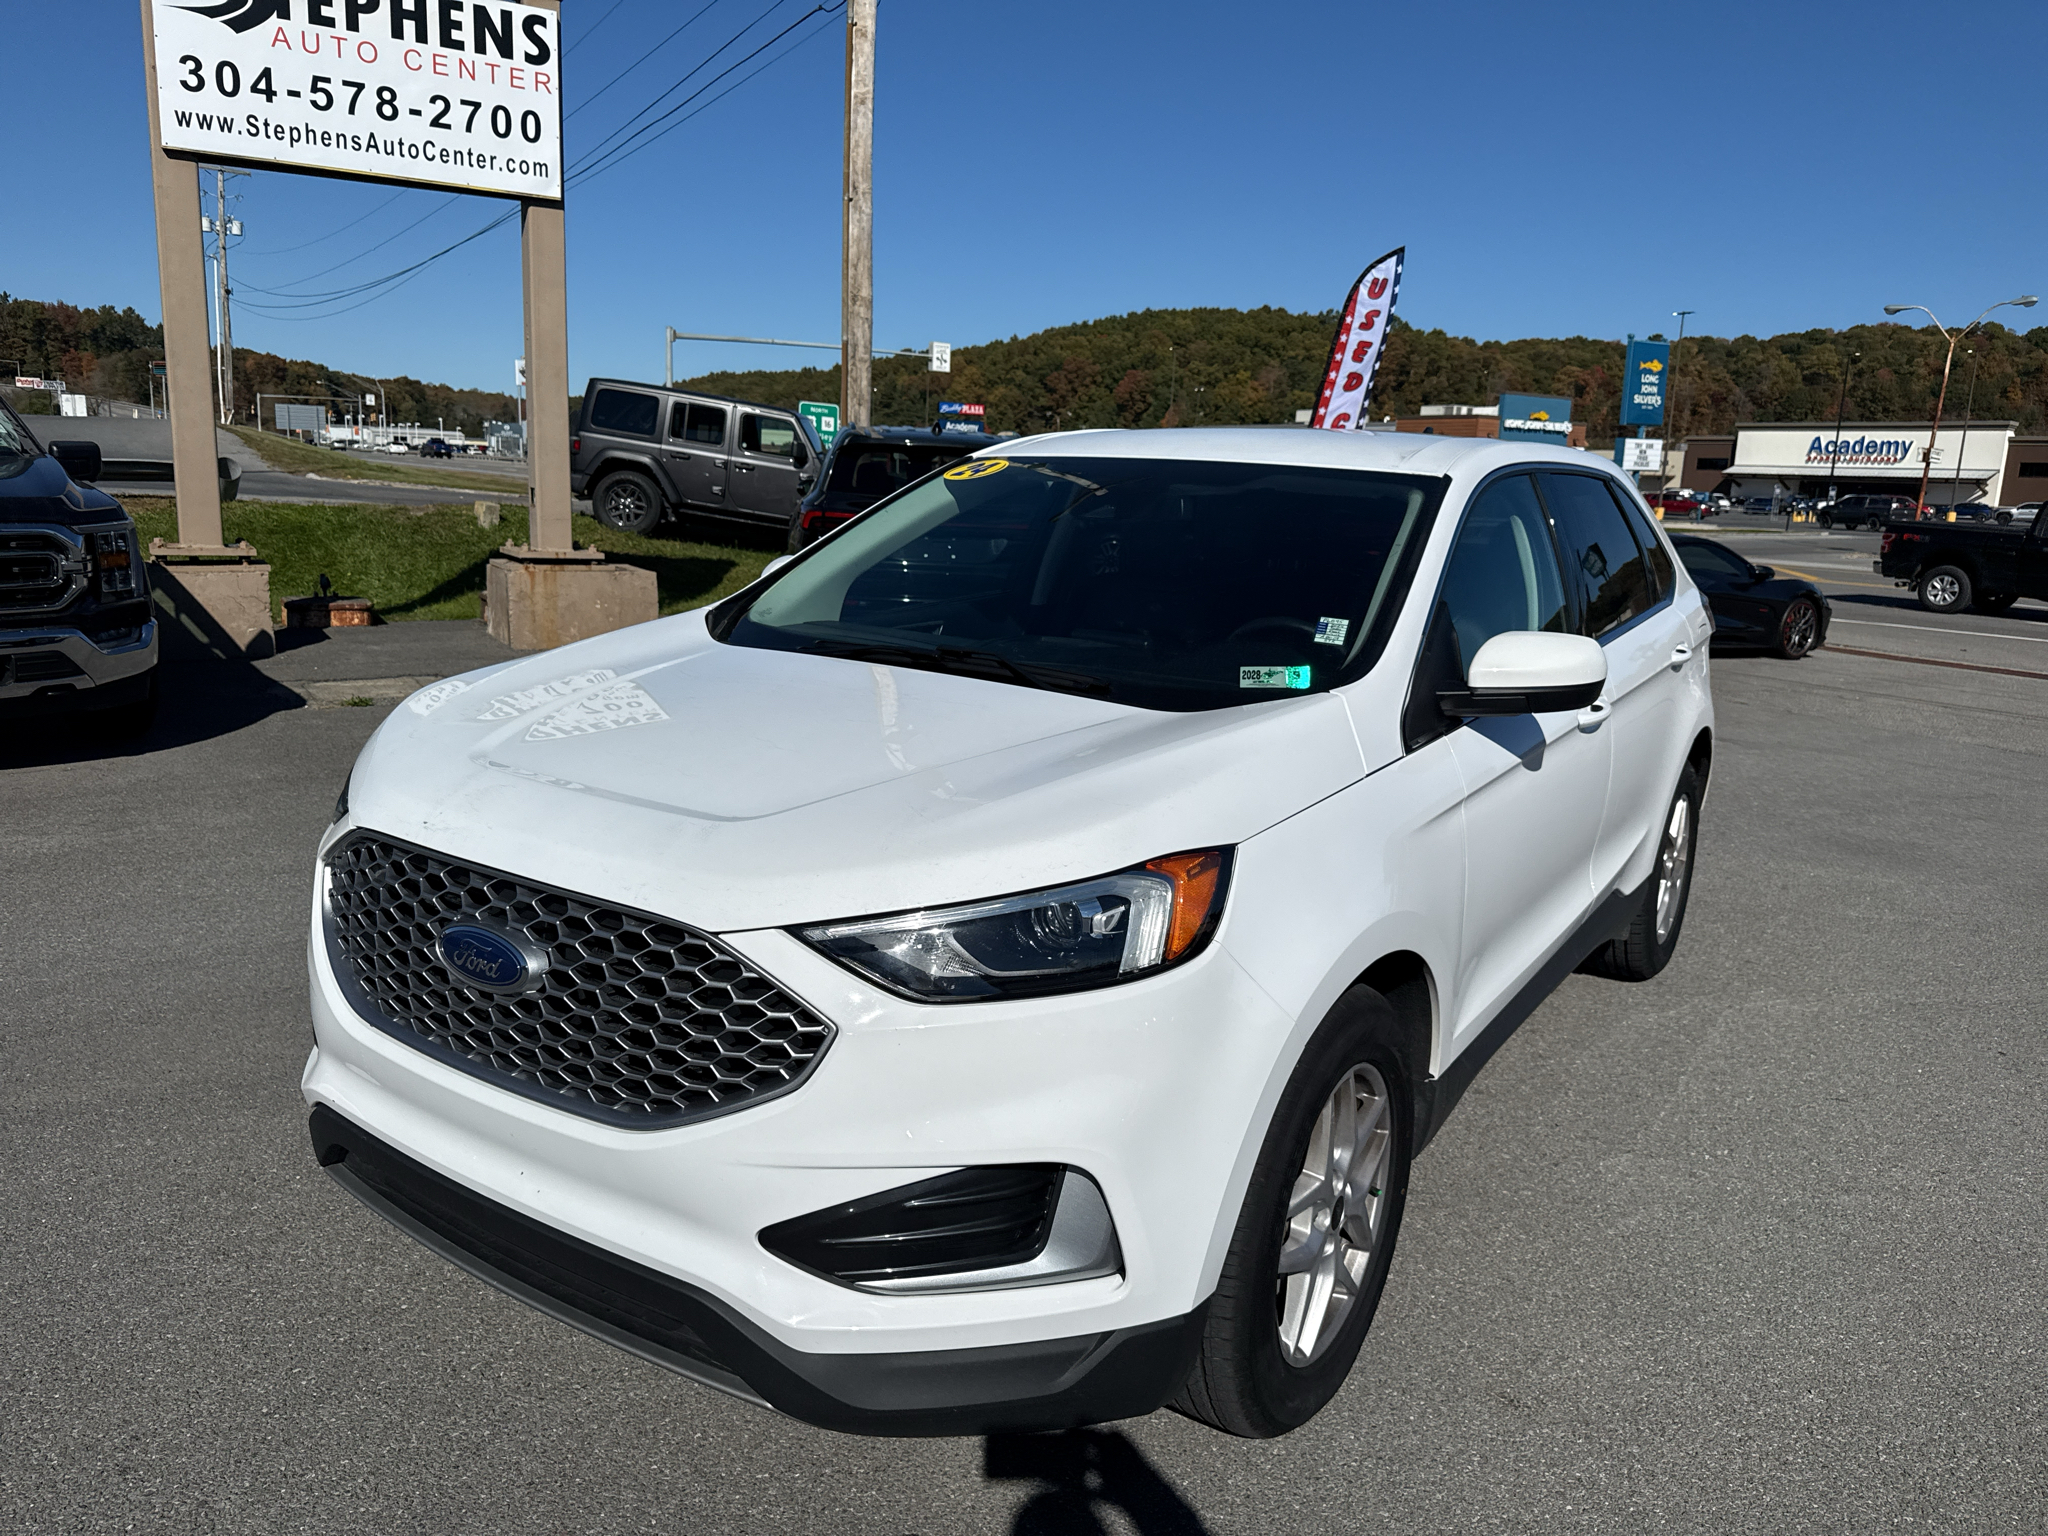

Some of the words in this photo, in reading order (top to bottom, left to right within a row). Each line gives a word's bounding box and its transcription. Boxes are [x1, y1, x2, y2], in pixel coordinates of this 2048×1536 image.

[161, 0, 551, 66] EPHENS
[271, 26, 379, 64] AUTO
[403, 48, 553, 94] CENTER
[178, 54, 542, 144] 304-578-2700
[174, 108, 549, 178] www.StephensAutoCenter.com
[1342, 277, 1388, 392] USED
[1640, 384, 1658, 394] JOHN
[1641, 373, 1660, 384] LONG
[824, 420, 832, 429] 16
[1806, 435, 1914, 461] Academy
[1241, 670, 1261, 680] 2028
[453, 938, 504, 978] Ford
